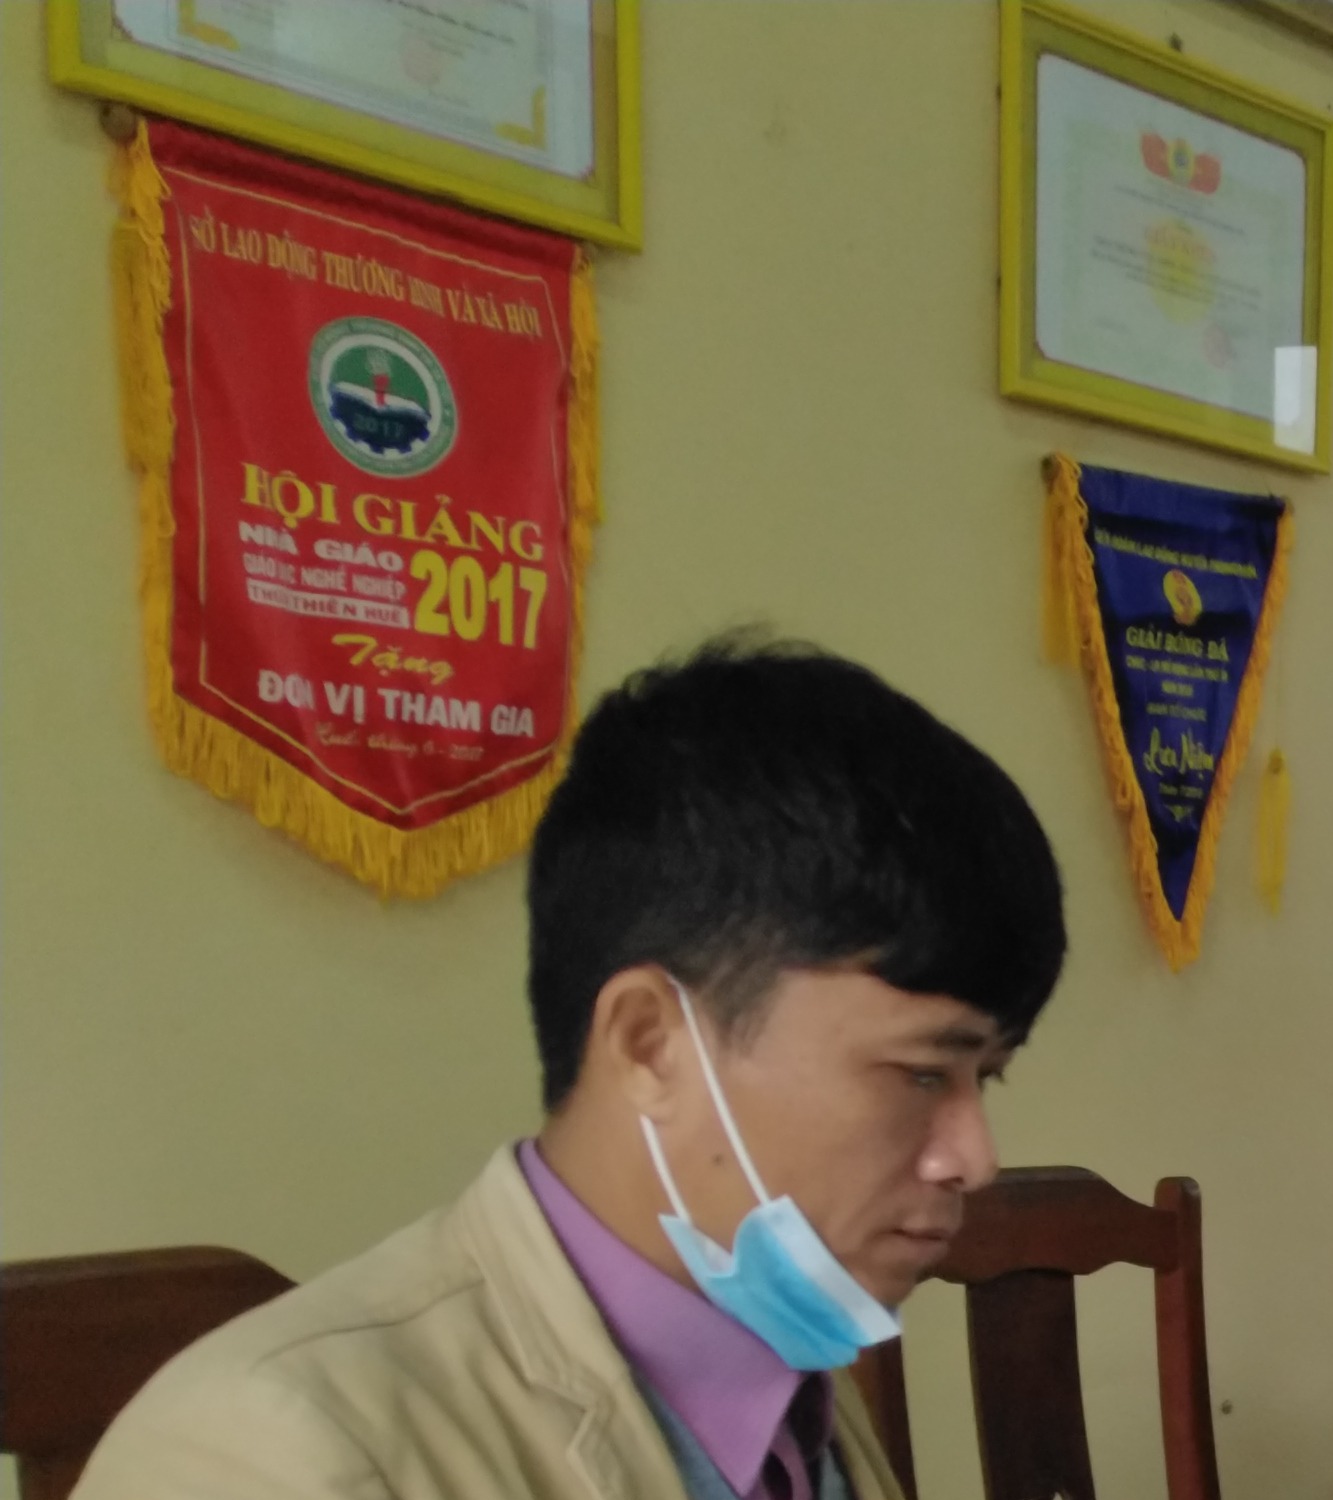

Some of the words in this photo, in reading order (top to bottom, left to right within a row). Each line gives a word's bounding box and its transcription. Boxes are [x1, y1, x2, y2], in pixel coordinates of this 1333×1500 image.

[240, 461, 340, 529] HỘI
[353, 492, 545, 562] GIẢNG
[313, 539, 404, 572] GIÁO
[409, 549, 548, 650] 2017
[377, 687, 481, 733] THAM
[490, 703, 535, 738] GIA
